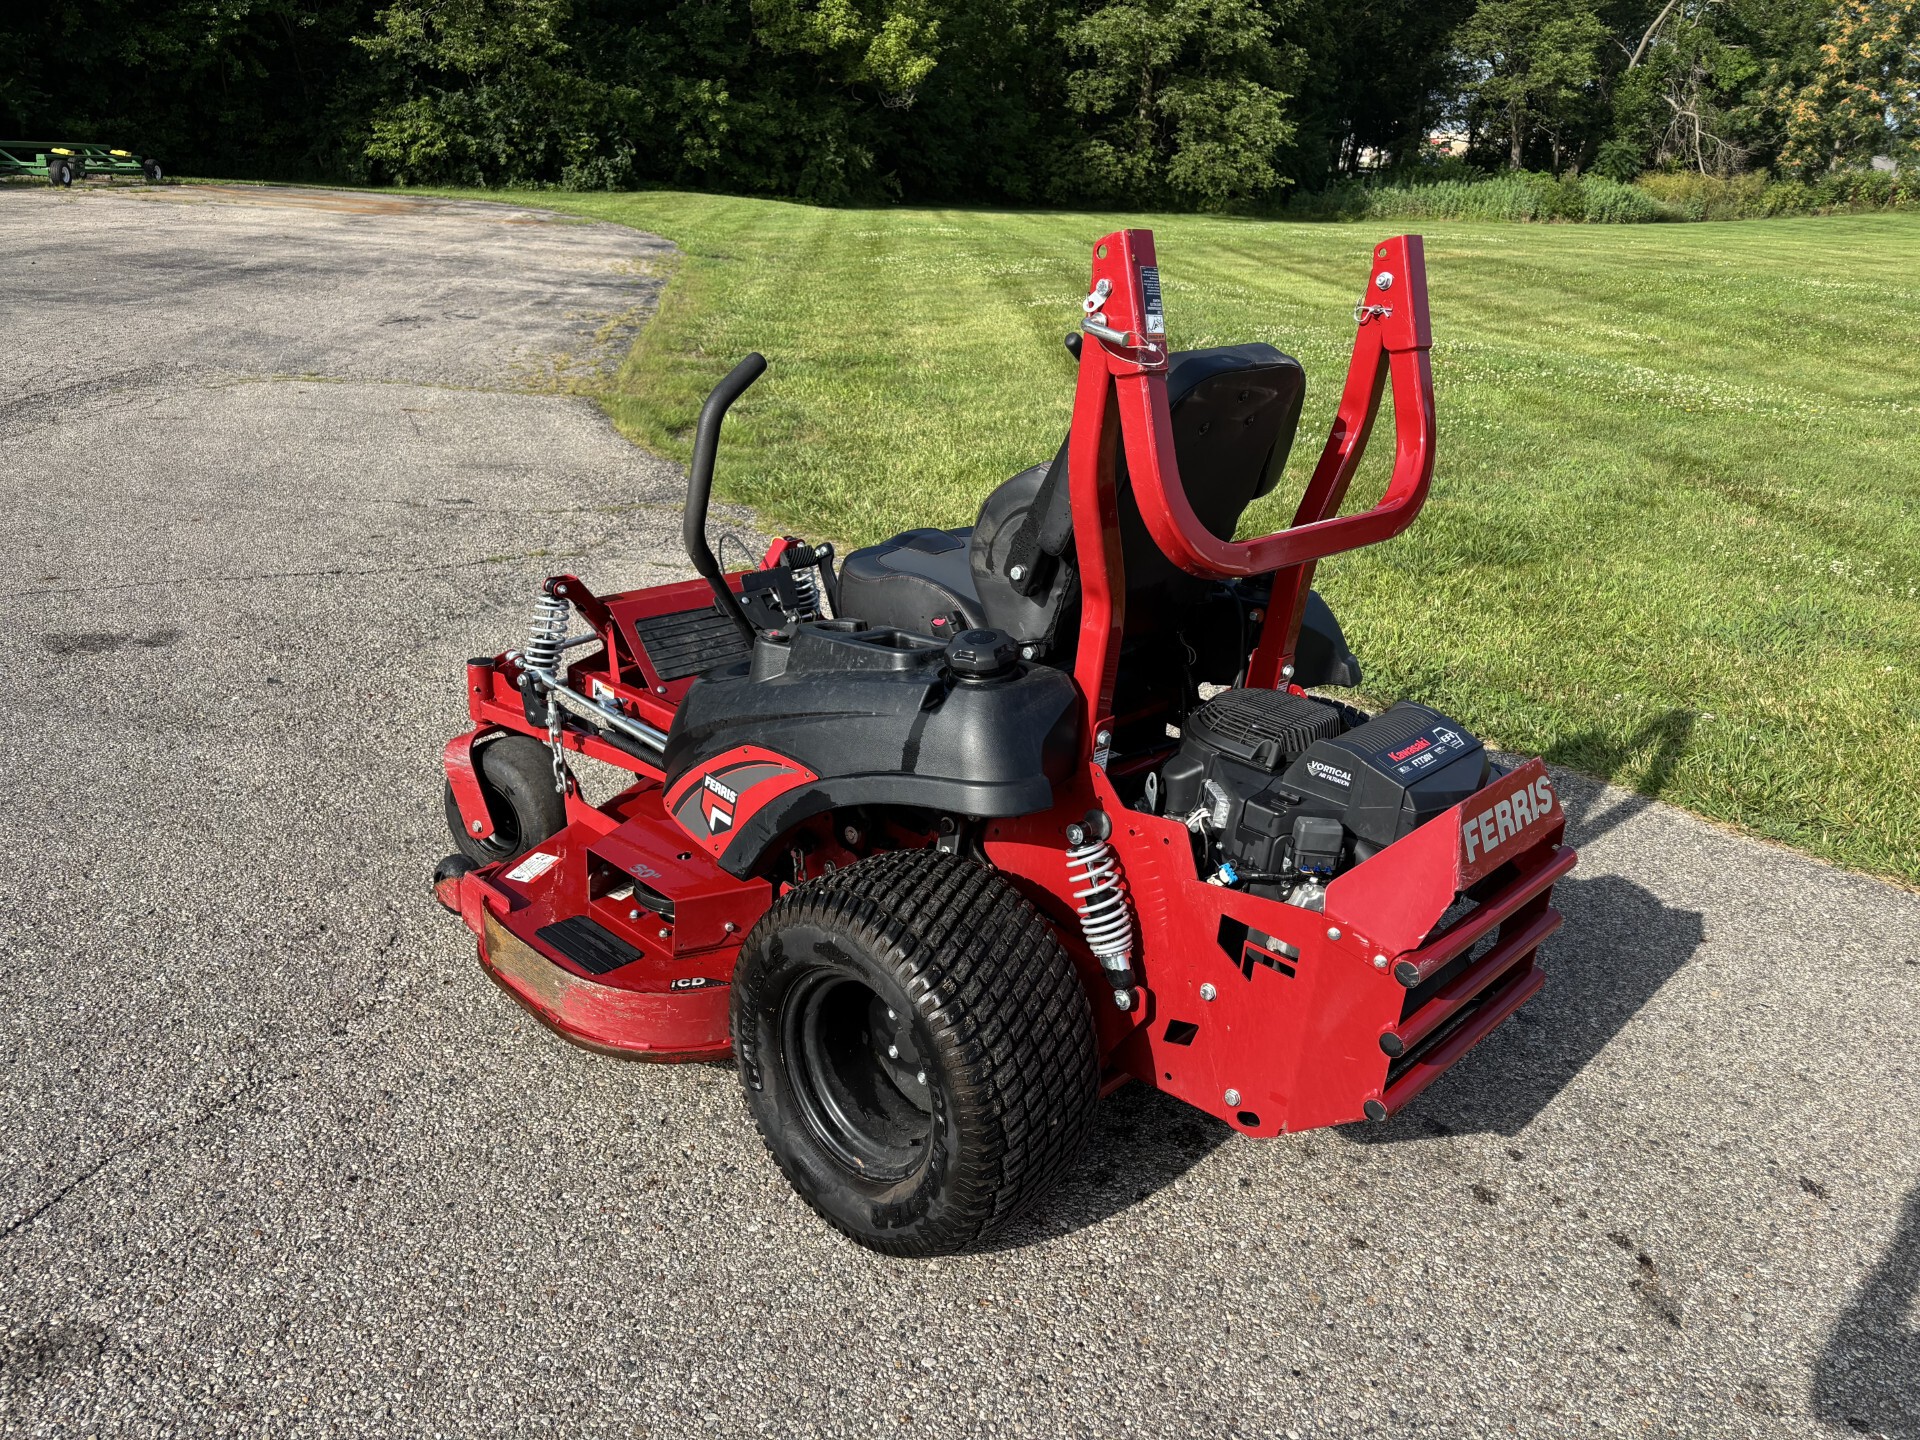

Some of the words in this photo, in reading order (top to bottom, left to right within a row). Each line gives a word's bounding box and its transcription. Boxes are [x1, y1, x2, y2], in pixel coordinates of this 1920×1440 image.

[1440, 732, 1455, 744] EFI
[1387, 736, 1431, 762] Kawasaki
[1311, 760, 1352, 781] VORTICAL
[1326, 774, 1350, 787] FILTRATION
[704, 775, 738, 804] FERRIS
[1462, 775, 1553, 864] FERRIS
[671, 977, 706, 988] iCD
